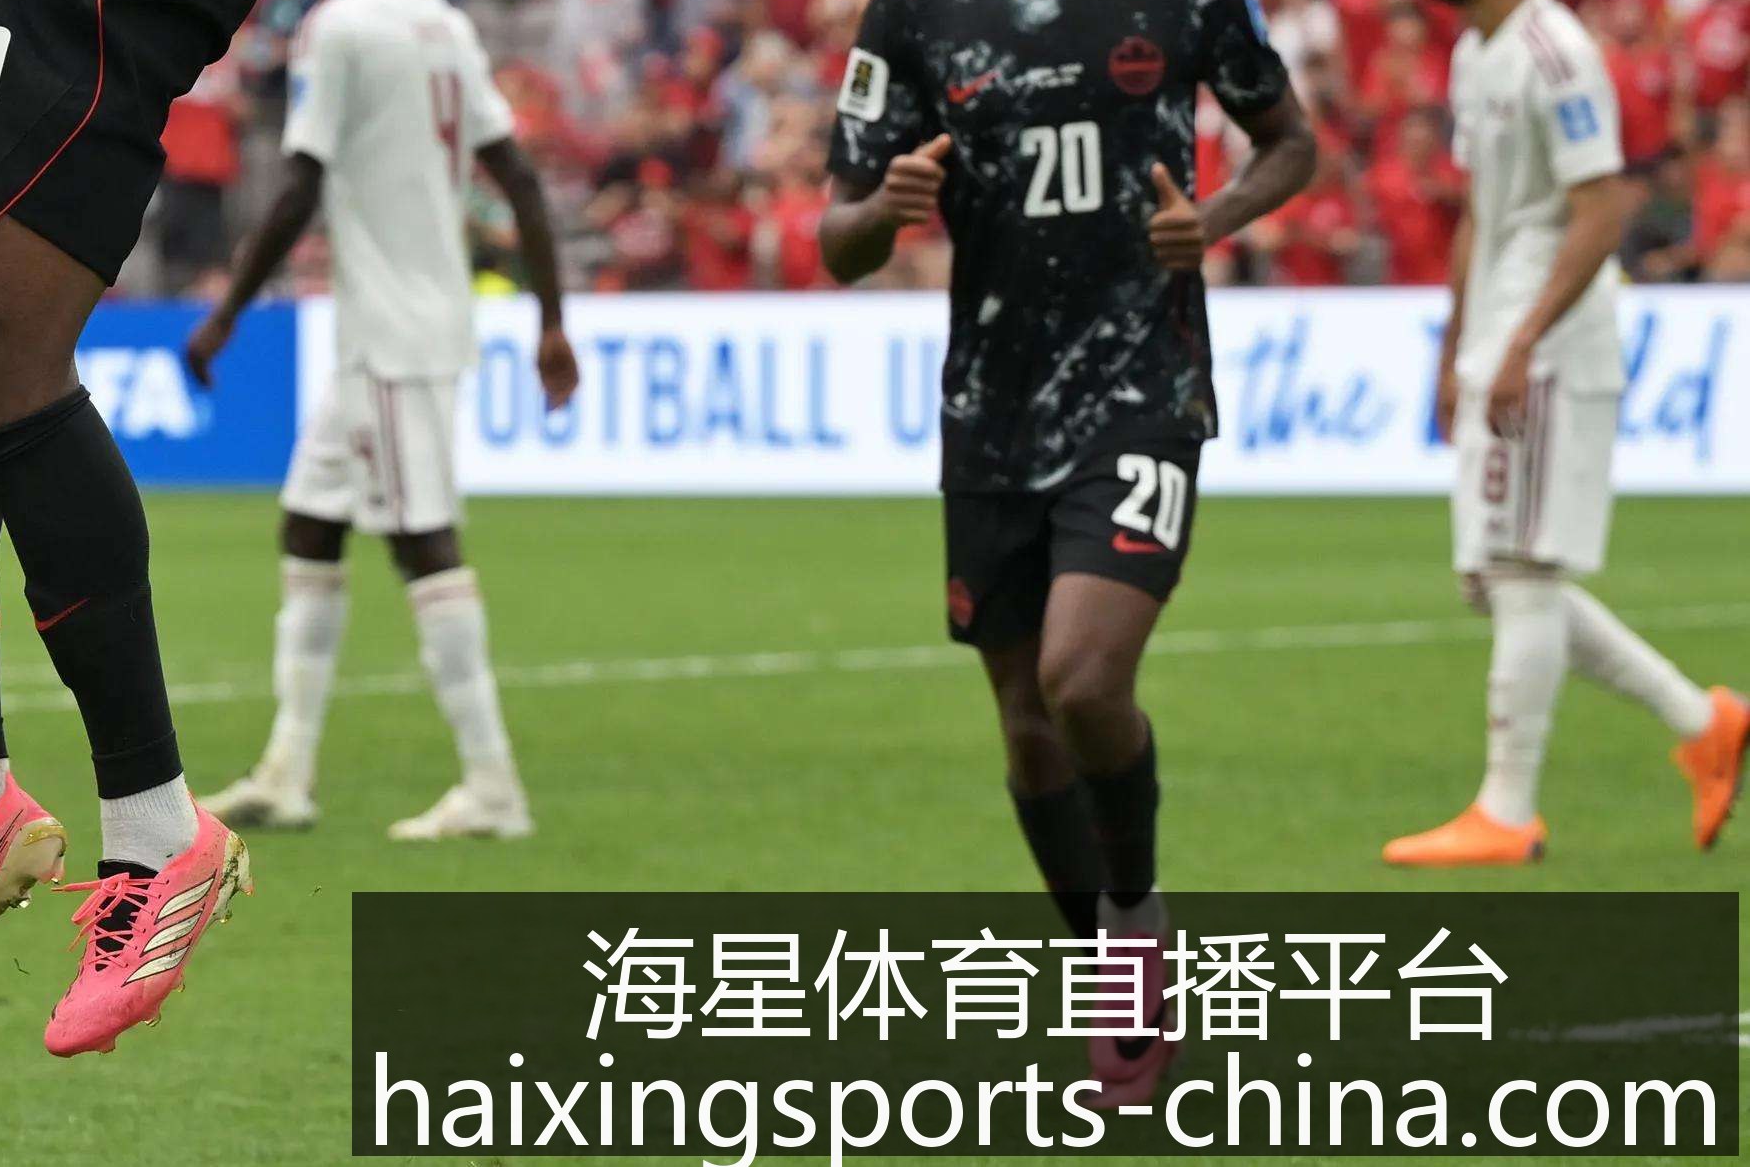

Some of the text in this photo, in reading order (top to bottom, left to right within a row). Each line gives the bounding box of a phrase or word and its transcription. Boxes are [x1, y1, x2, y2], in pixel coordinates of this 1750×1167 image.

[1018, 121, 1103, 218] 20
[76, 345, 198, 439] FA
[476, 336, 844, 447] OTBALL
[1232, 315, 1395, 448] the
[1110, 453, 1187, 549] 20
